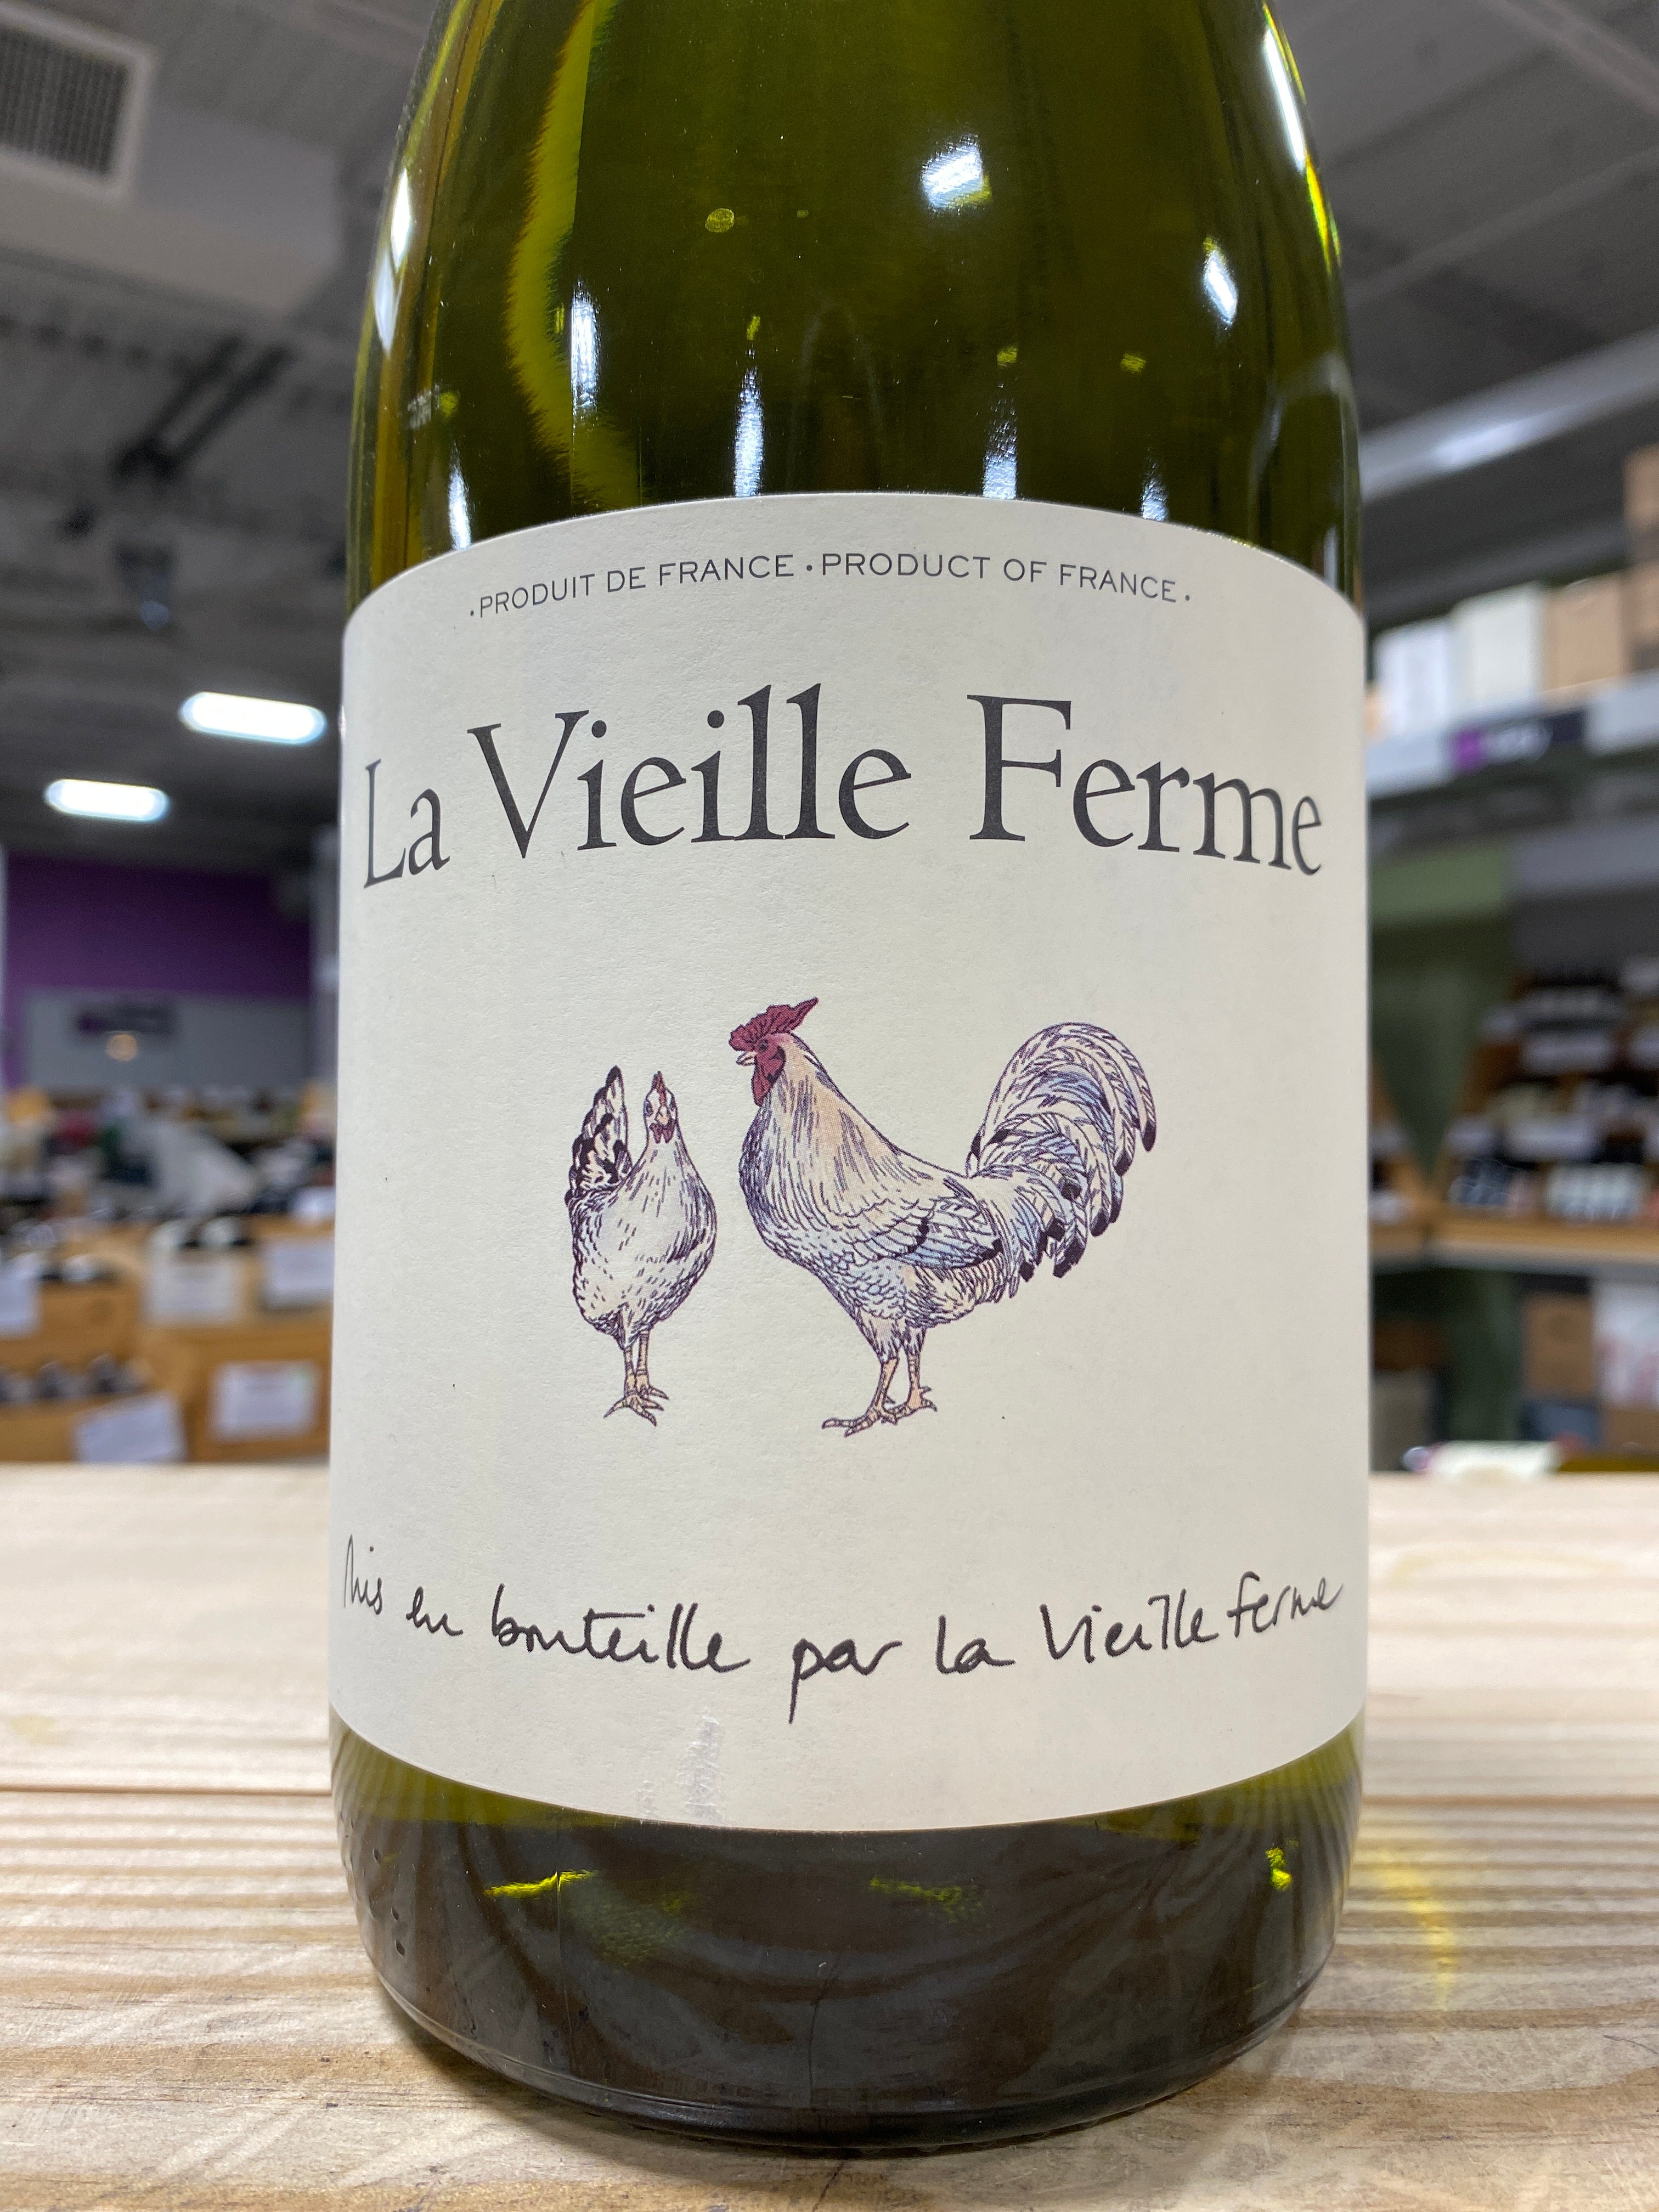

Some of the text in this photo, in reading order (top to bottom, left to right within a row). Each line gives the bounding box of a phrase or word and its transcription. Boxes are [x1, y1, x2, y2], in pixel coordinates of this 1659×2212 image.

[607, 566, 646, 592] DE
[659, 554, 794, 586] FRANCE
[1003, 558, 1047, 583] OF
[364, 683, 1322, 889] La Vieille Ferme
[405, 1586, 464, 1637] en
[491, 1583, 752, 1674] bouteille
[788, 1638, 903, 1725] par
[935, 1614, 1016, 1675] la
[1226, 1571, 1344, 1638] ferme
